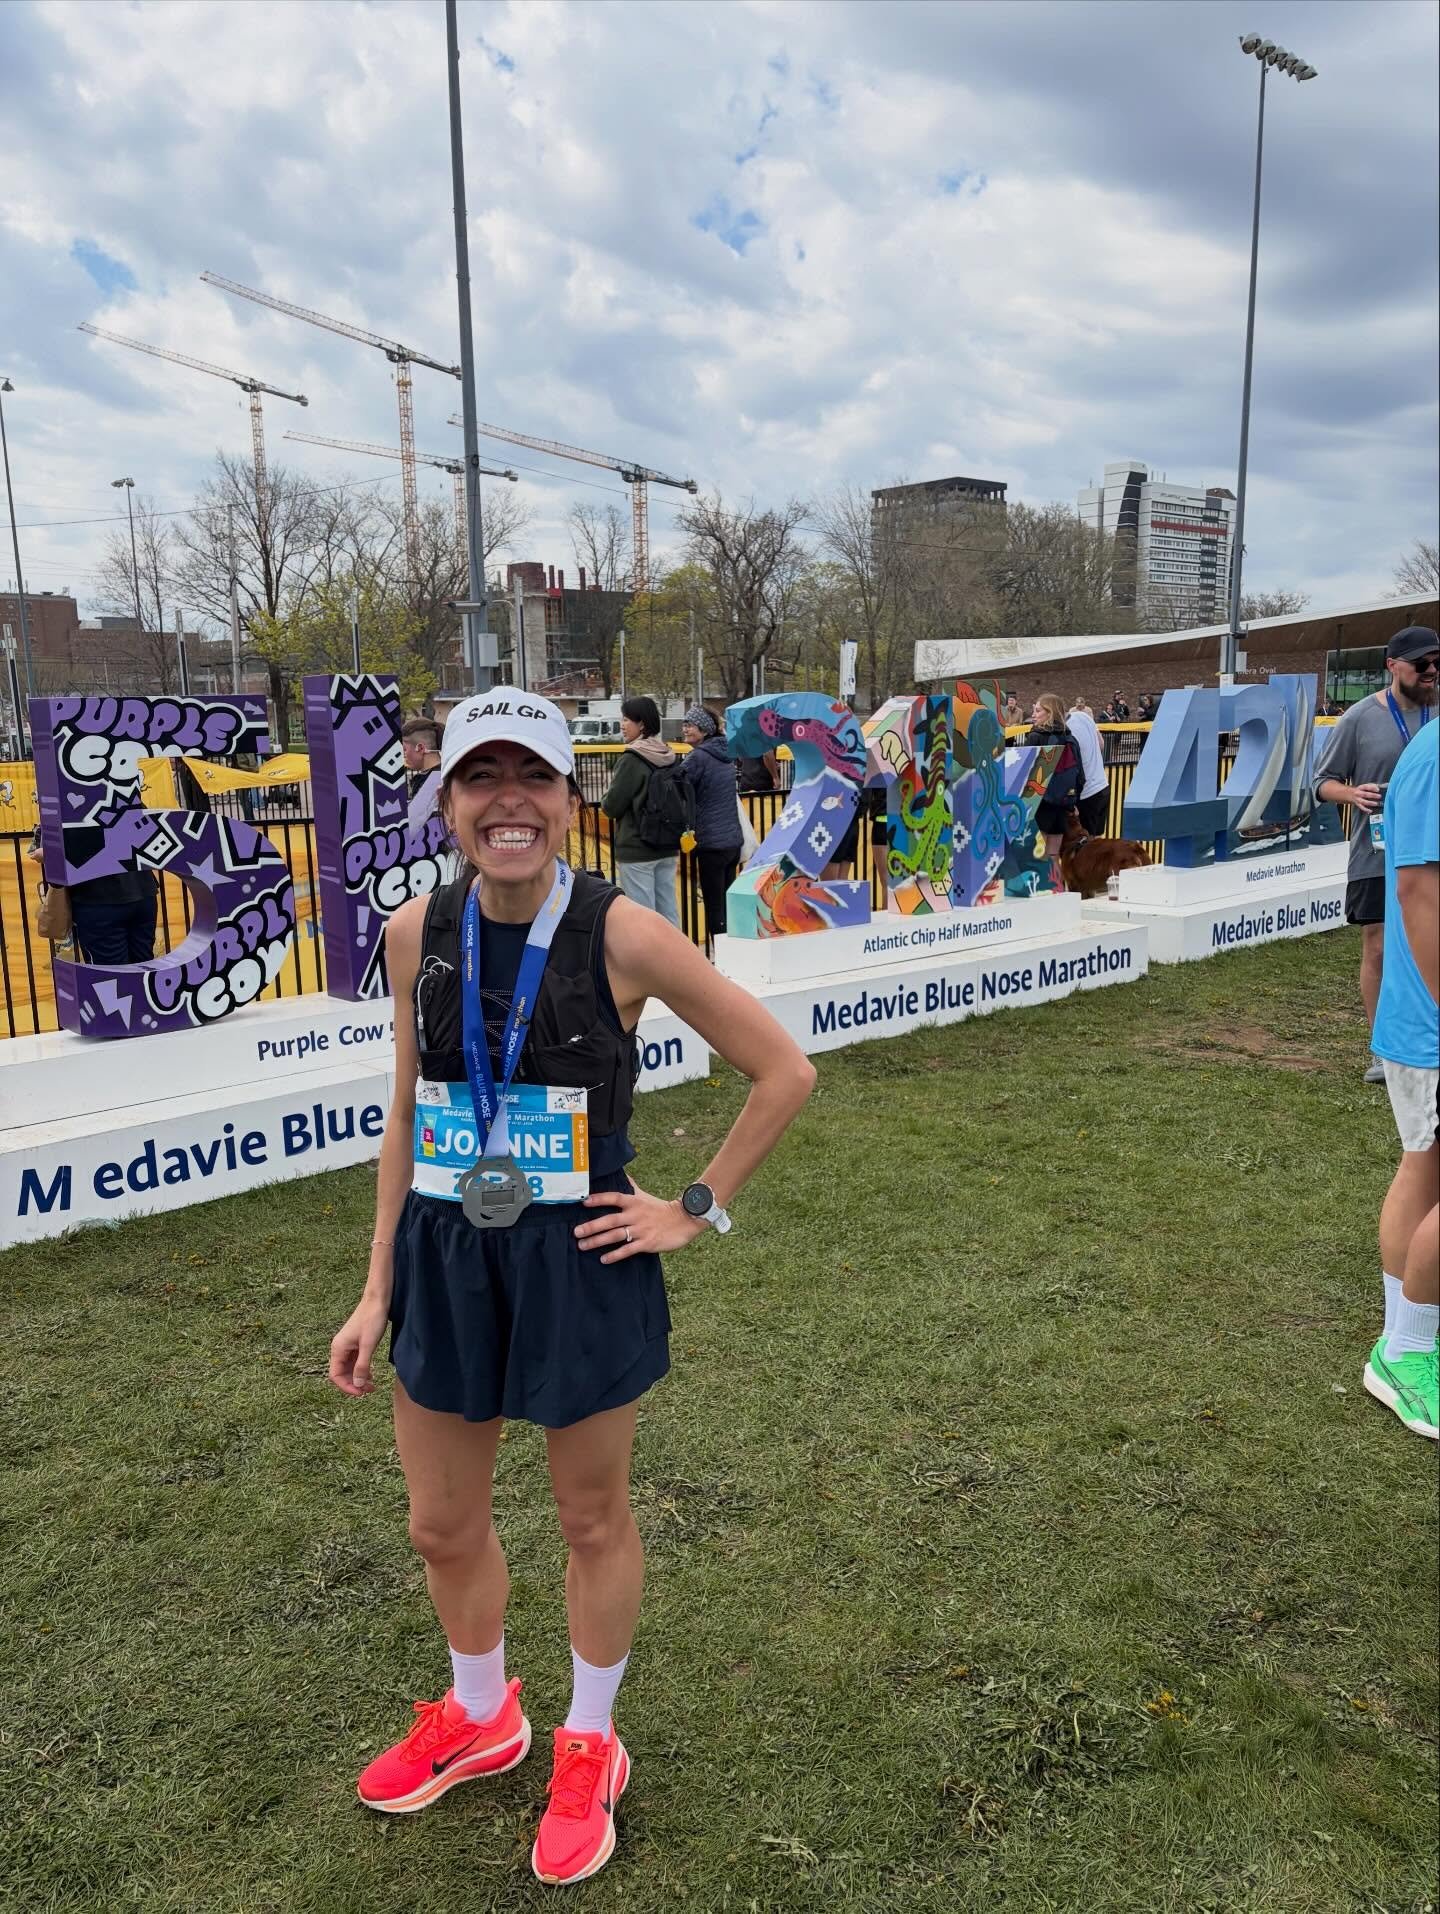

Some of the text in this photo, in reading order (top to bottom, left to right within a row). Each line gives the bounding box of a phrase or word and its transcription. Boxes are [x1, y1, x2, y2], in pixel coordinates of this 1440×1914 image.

[1259, 666, 1277, 675] Oval
[50, 697, 238, 753] PURPLE
[1246, 861, 1306, 883] Medavie Marathon
[863, 916, 1012, 954] Atlantic Chip Half Marathon
[1212, 900, 1341, 947] Medavie Blue Nose
[812, 945, 1131, 1036] Medavie Blue Nose Marathon
[257, 1030, 329, 1062] Purple
[338, 1023, 384, 1046] Cow
[281, 1102, 386, 1158] Blue
[442, 1108, 473, 1118] Medavie
[514, 1113, 555, 1123] Marathon
[436, 1128, 570, 1159] JONNE
